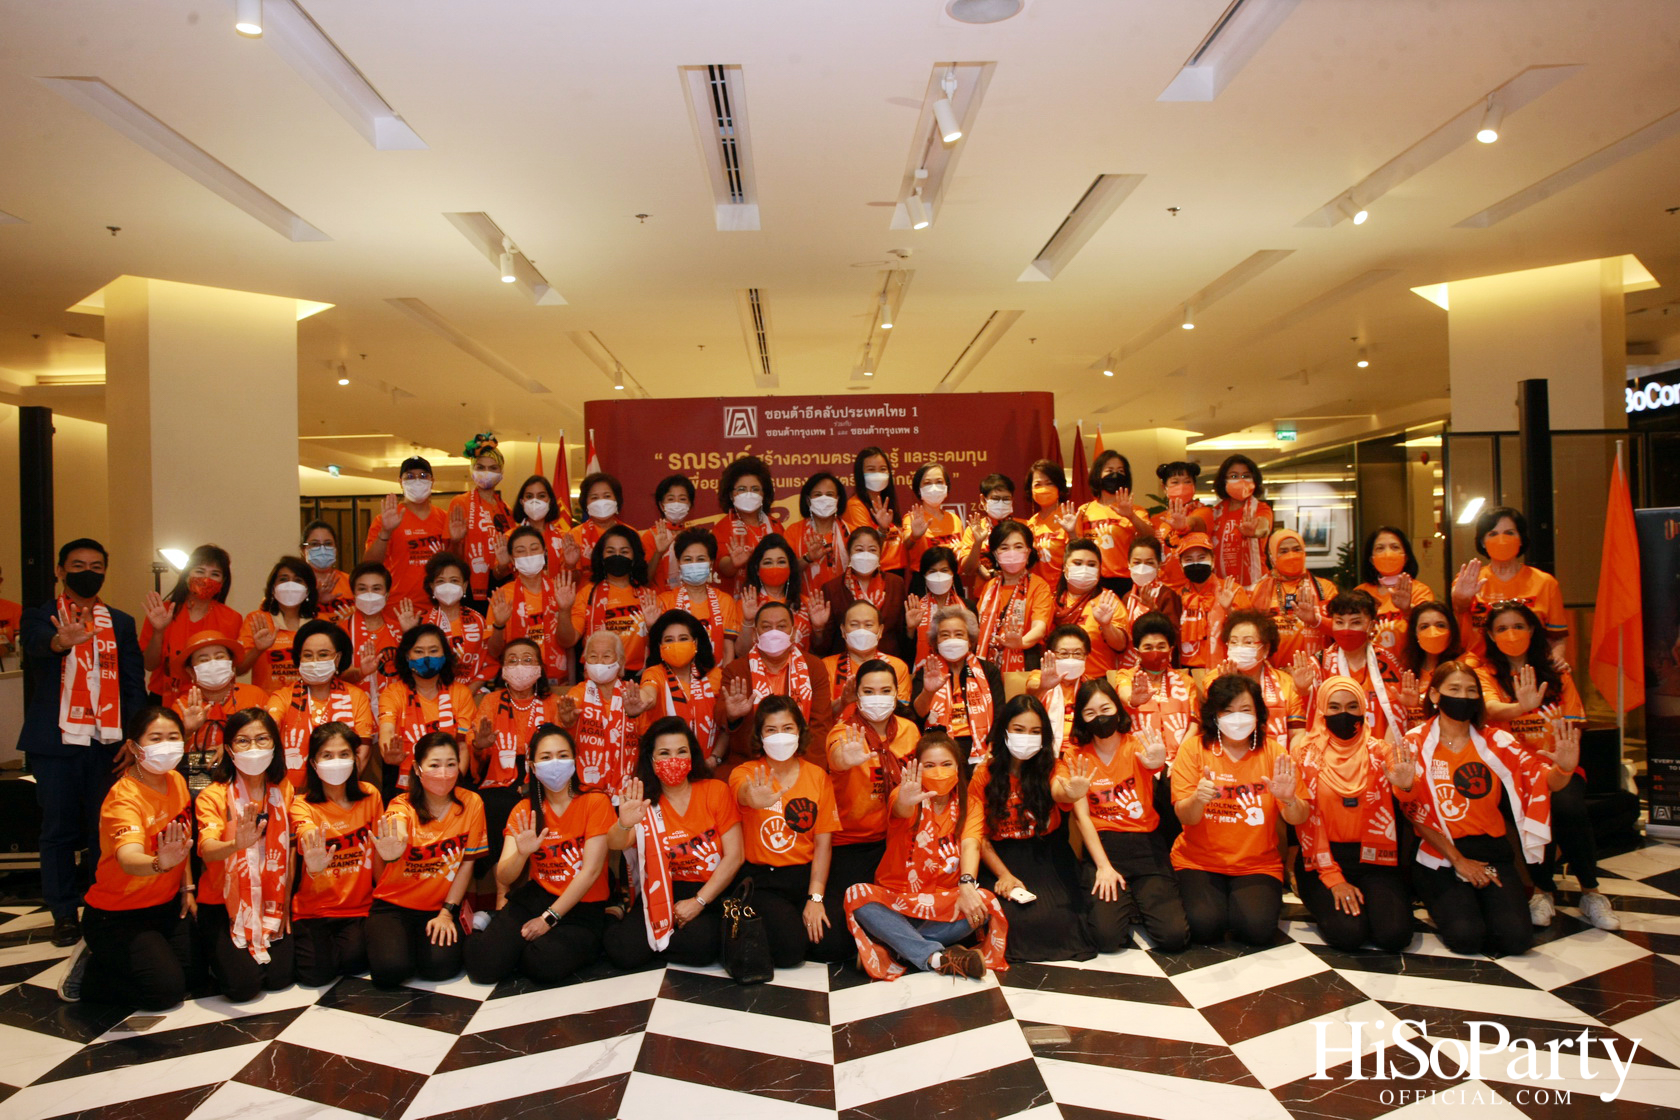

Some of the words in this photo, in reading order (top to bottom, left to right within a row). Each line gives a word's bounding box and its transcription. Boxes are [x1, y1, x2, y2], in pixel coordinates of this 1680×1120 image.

[911, 406, 919, 417] 1
[829, 428, 835, 436] 1
[913, 427, 920, 435] 8
[605, 604, 640, 620] STO
